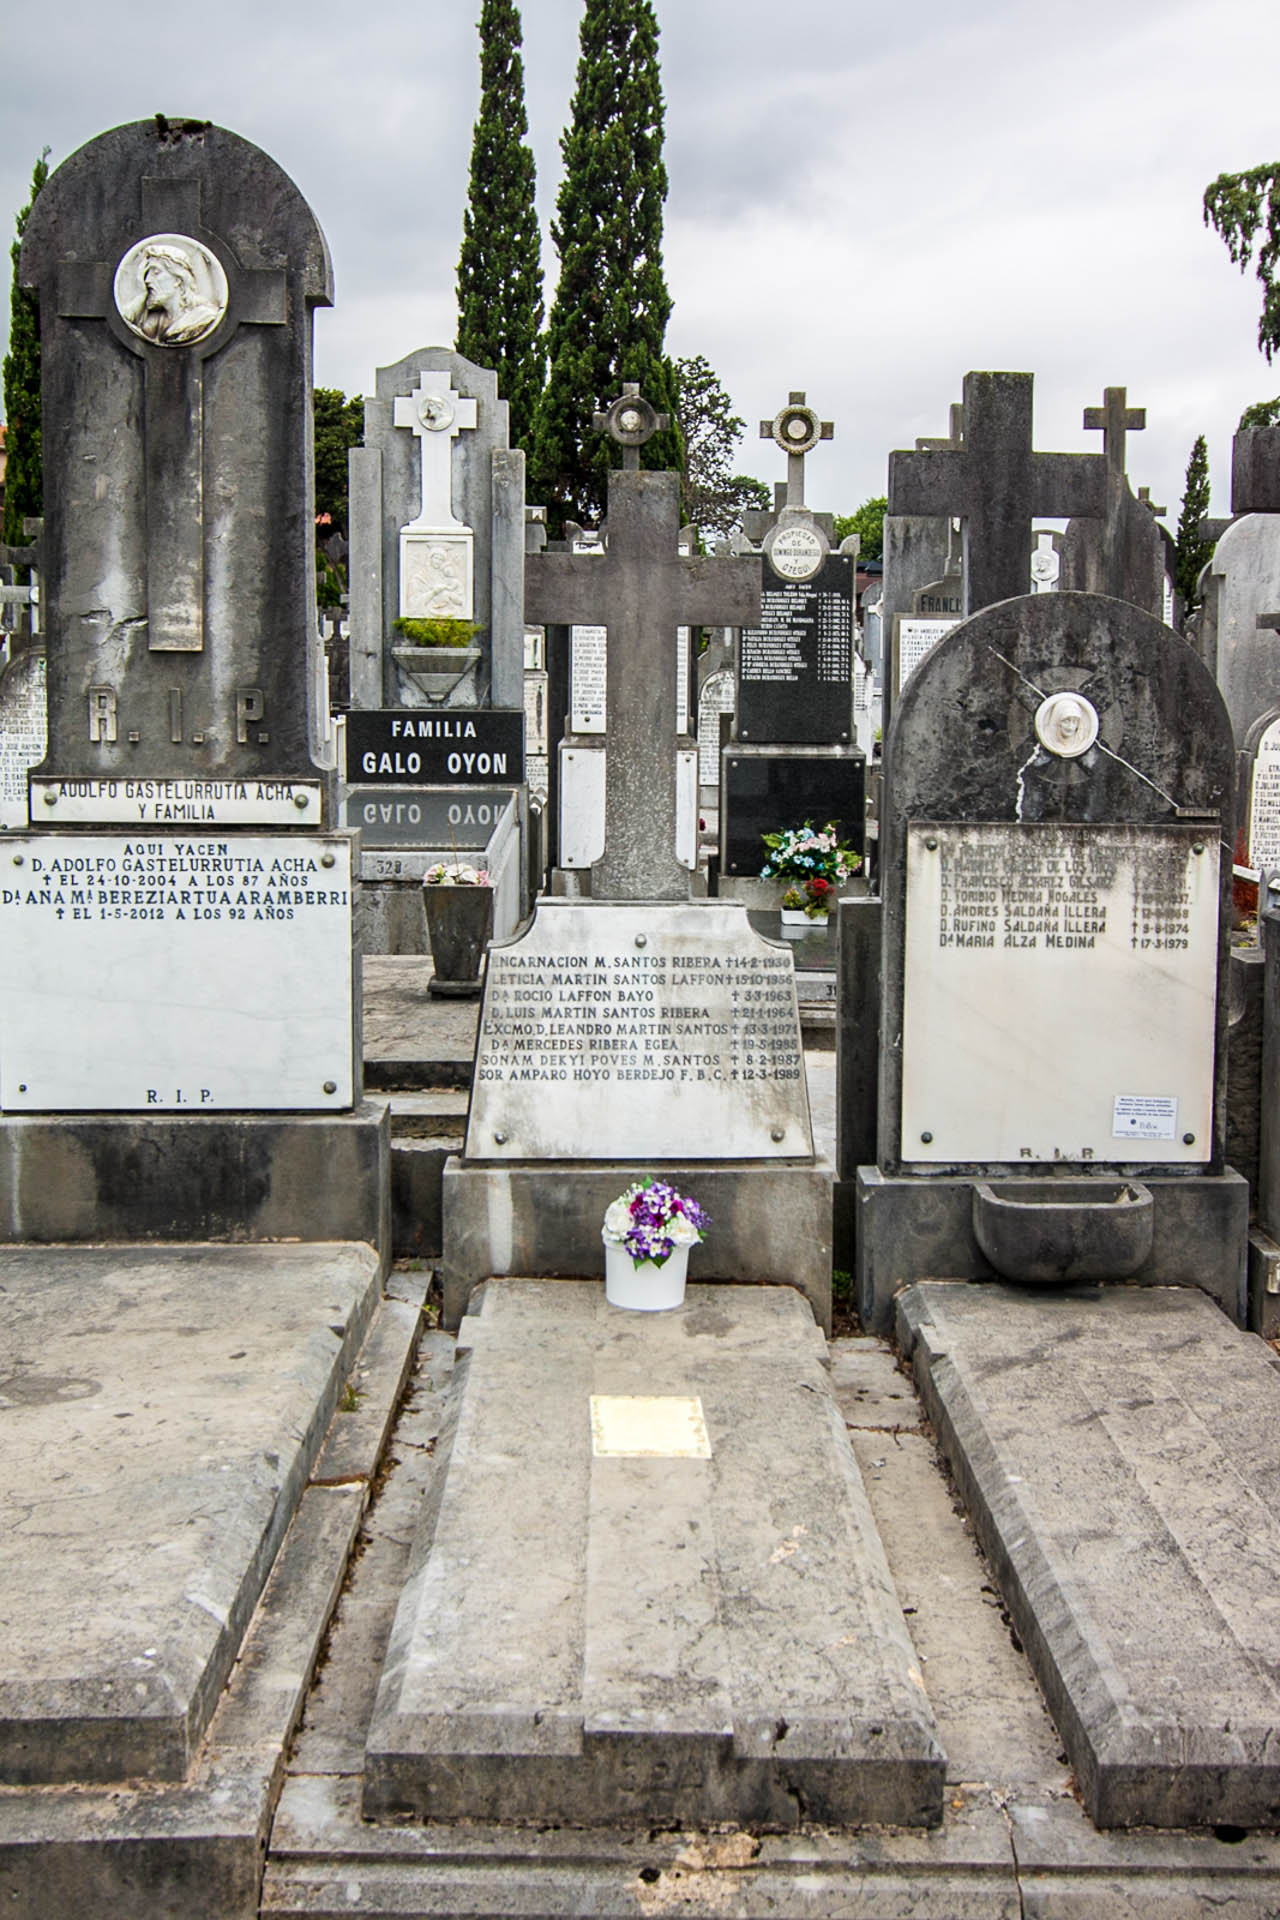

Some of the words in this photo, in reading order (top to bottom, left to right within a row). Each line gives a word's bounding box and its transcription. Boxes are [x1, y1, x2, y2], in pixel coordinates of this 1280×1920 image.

[392, 720, 477, 738] FAMILIA
[362, 752, 422, 774] GALO
[448, 752, 507, 774] OYON
[59, 782, 117, 799] ADOLFO
[126, 782, 247, 800] GASTELURRUTIA
[256, 784, 294, 800] ACHA
[138, 803, 146, 819] Y
[155, 804, 215, 820] FAMILIA
[124, 844, 163, 856] AQUI
[175, 844, 228, 856] YACEN
[32, 858, 46, 872] D.
[52, 858, 116, 872] ADOLFO
[122, 858, 264, 872] GASTELURRUTIA
[272, 858, 318, 872] ACHA
[60, 875, 79, 886] EL
[87, 875, 176, 886] 24-10-2004
[188, 876, 198, 887] A
[206, 876, 235, 887] LOS
[242, 876, 259, 887] 87
[268, 873, 308, 887] AÑOS
[26, 890, 66, 904] ANA
[98, 890, 231, 905] BEREZIARTUA
[236, 890, 347, 905] ARAMBERRI
[954, 890, 996, 903] TORIBIO
[73, 908, 92, 920] EL
[100, 908, 165, 920] 1-5-2012
[176, 908, 186, 920] A
[194, 908, 221, 920] LOS
[229, 908, 246, 920] 92
[254, 906, 294, 920] AÑOS
[1004, 904, 1059, 917] SALDAÑA
[1064, 904, 1106, 918] ILLERA
[1004, 918, 1059, 932] SALDAÑA
[1064, 920, 1106, 933] ILLERA
[956, 934, 994, 947] MARIA
[1004, 934, 1037, 948] ALZA
[1046, 934, 1095, 948] MEDINA
[492, 956, 588, 968] ENCARNACION
[672, 956, 721, 968] RIBERA
[492, 974, 545, 985] LETICIA
[552, 974, 608, 985] MARTIN
[613, 974, 666, 985] SANTOS
[672, 974, 725, 985] LAFFON
[514, 990, 553, 1001] ROCIO
[559, 990, 612, 1001] LAFFON
[618, 990, 654, 1001] BAYO
[542, 1008, 597, 1019] MARTIN
[603, 1008, 656, 1019] SANTOS
[662, 1008, 710, 1019] RIBERA
[617, 1024, 671, 1035] MARTIN
[676, 1024, 728, 1035] SANTOS
[514, 1040, 583, 1051] MERCEDES
[589, 1040, 638, 1051] RIBERA
[645, 1040, 679, 1051] EGEA
[482, 1055, 533, 1066] SONAM
[540, 1055, 585, 1066] DEKYI
[591, 1055, 637, 1066] POVES
[479, 1070, 504, 1081] SOR
[509, 1070, 568, 1081] AMPARO
[574, 1070, 611, 1081] HOYO
[617, 1070, 675, 1081] BERDEJO
[147, 1089, 163, 1103] R.
[200, 1089, 215, 1103] P.
